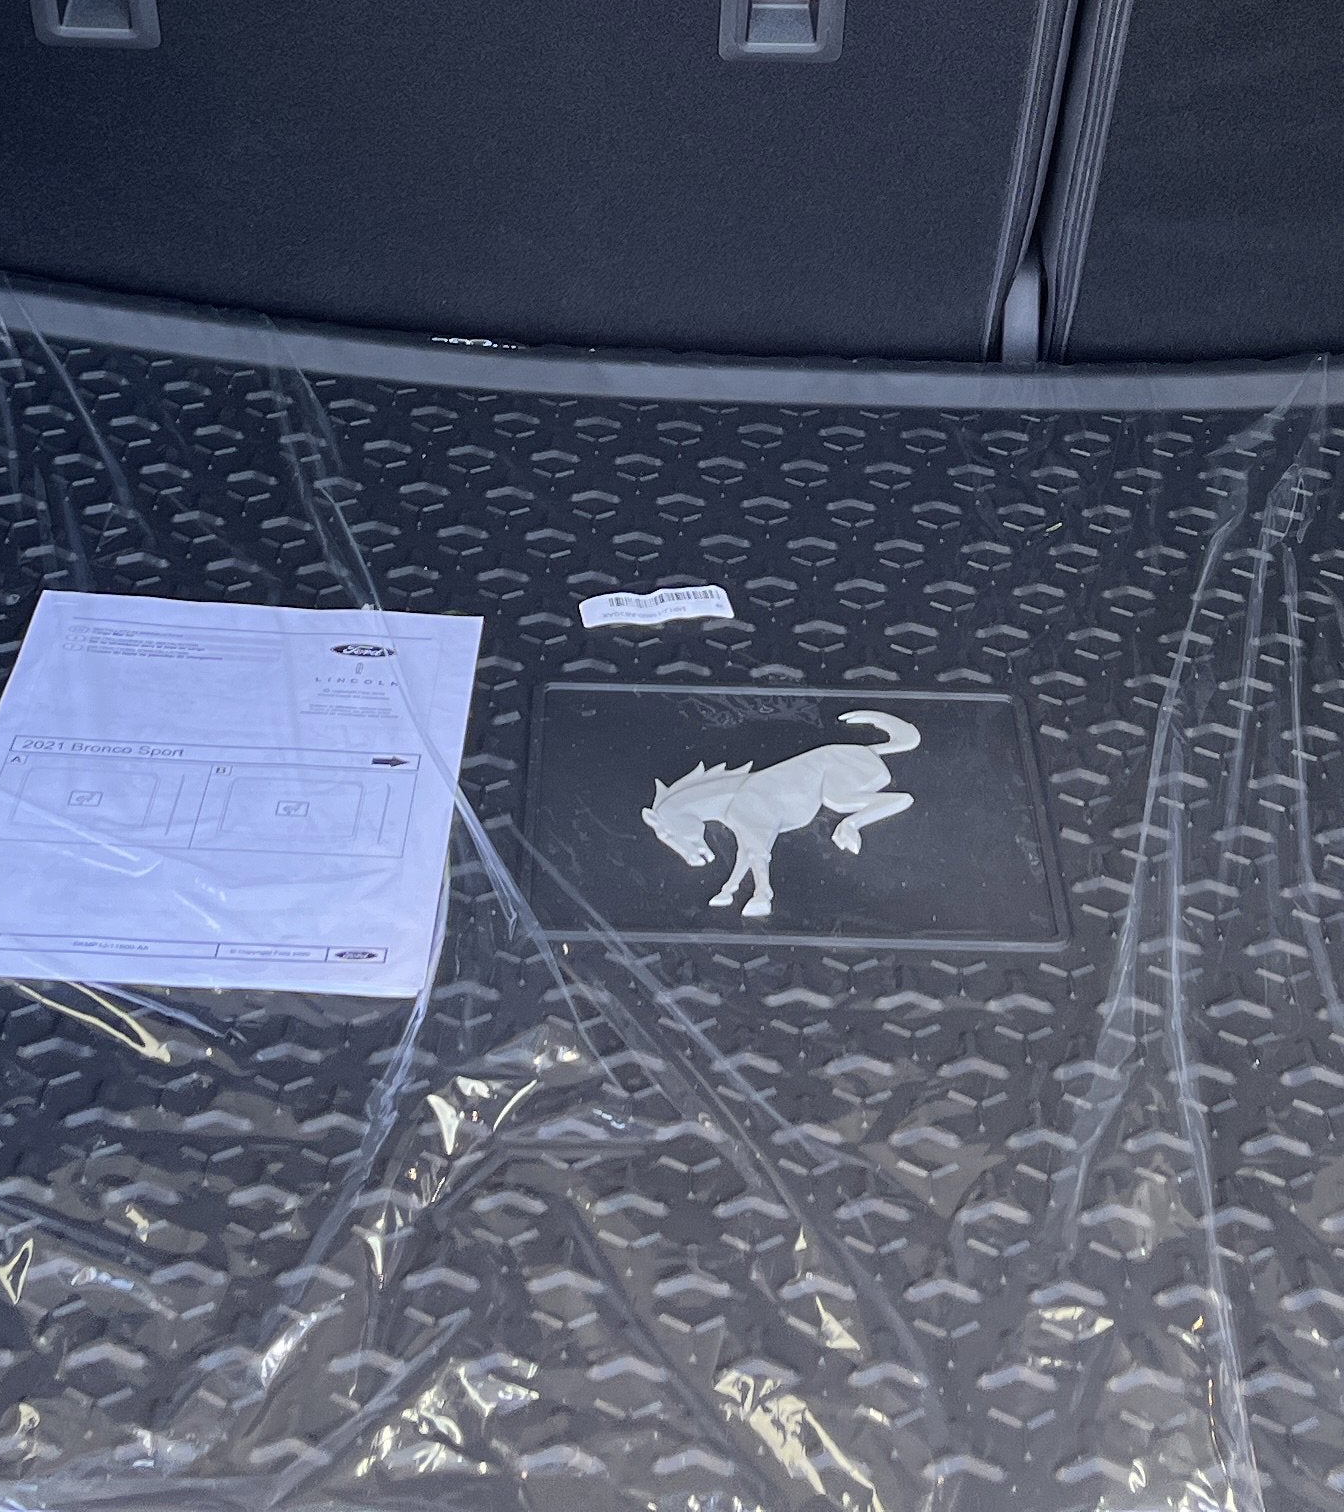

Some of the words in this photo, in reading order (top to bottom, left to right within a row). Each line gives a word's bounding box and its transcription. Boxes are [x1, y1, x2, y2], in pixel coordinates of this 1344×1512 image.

[22, 738, 66, 752] 2021
[69, 741, 134, 756] Bronco
[137, 744, 185, 759] Sport
[10, 754, 23, 765] A
